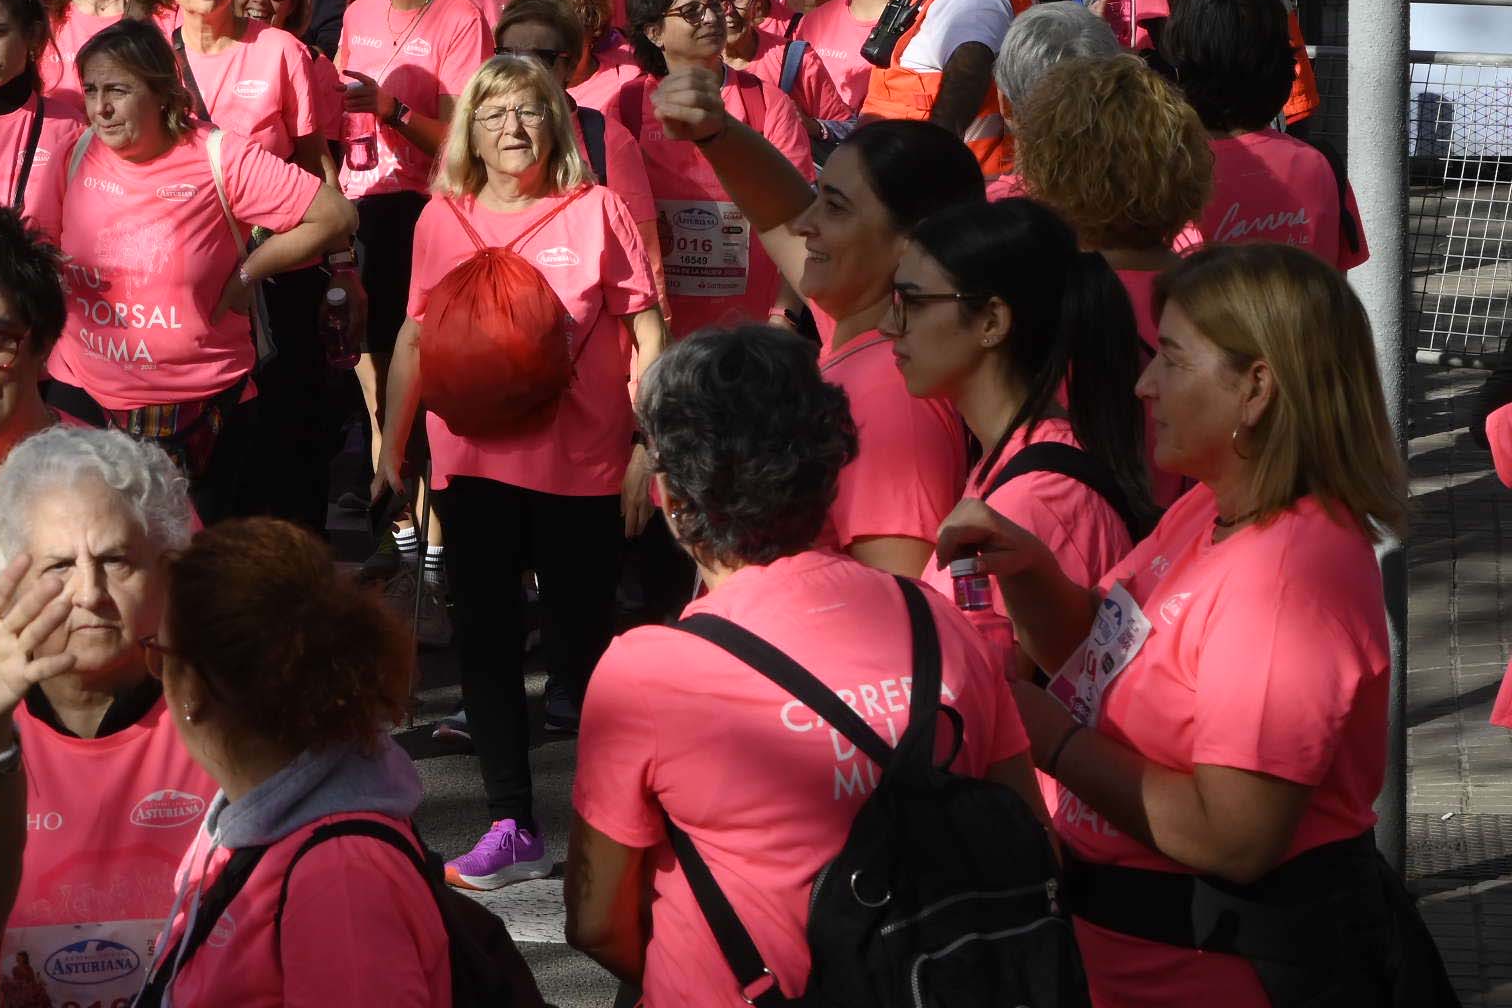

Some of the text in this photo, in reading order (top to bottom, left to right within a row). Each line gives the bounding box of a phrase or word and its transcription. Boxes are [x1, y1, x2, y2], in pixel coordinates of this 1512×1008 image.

[1214, 202, 1312, 241] Carrera
[677, 238, 713, 252] 016
[140, 803, 200, 820] ASTURIANA
[52, 957, 135, 976] ASTURIANA
